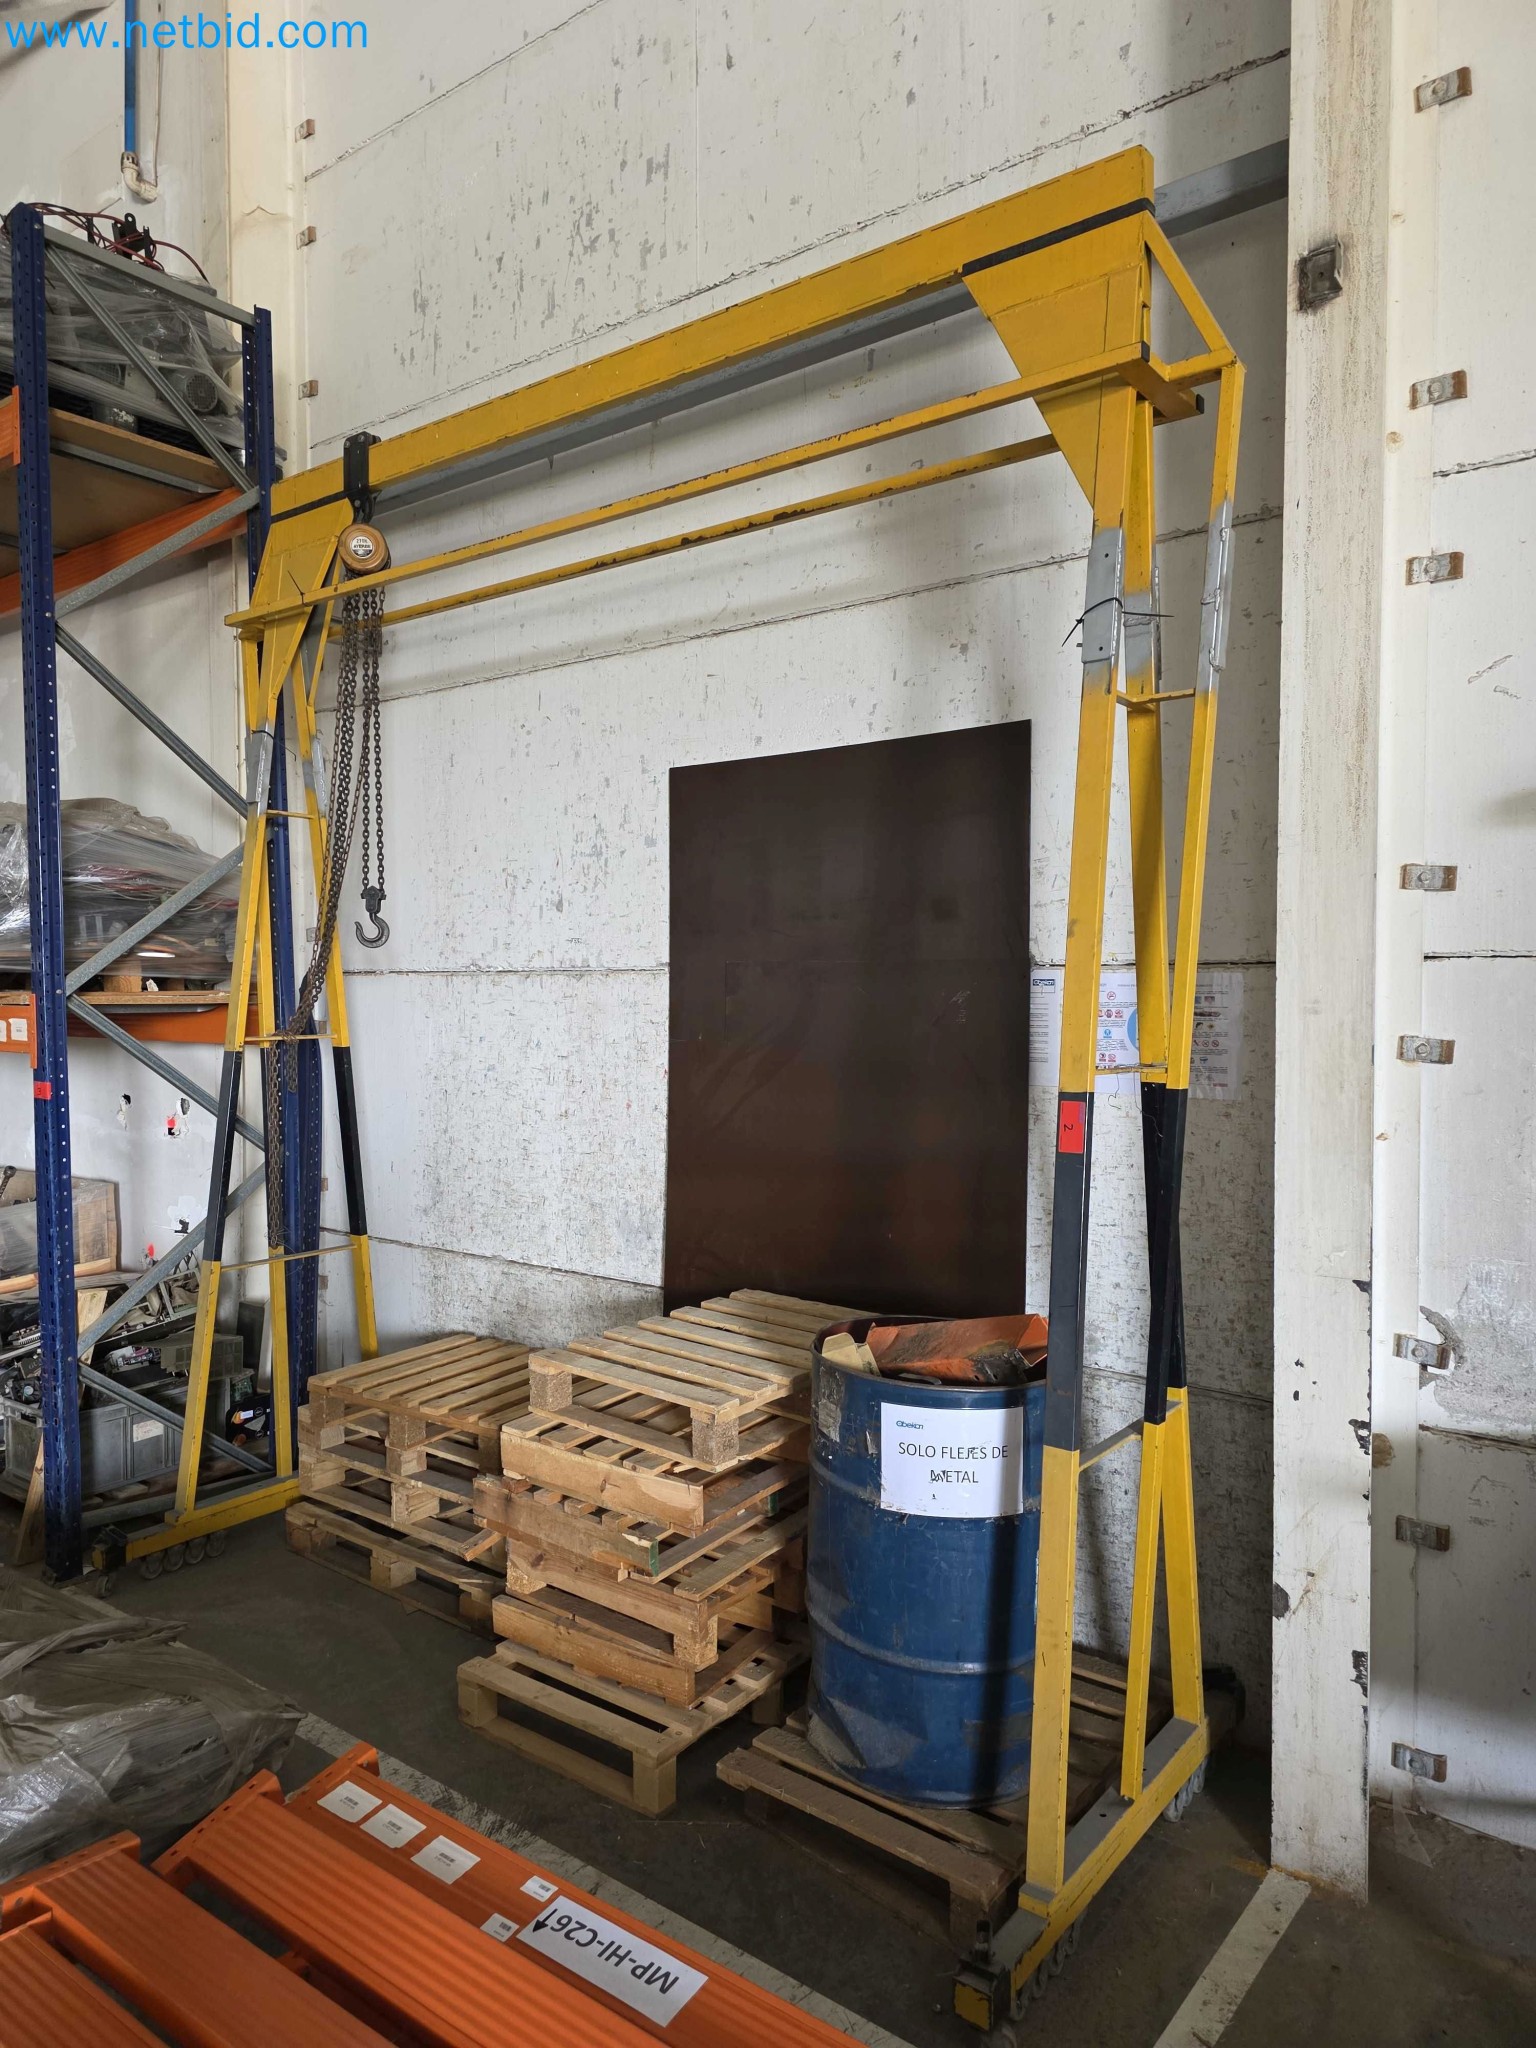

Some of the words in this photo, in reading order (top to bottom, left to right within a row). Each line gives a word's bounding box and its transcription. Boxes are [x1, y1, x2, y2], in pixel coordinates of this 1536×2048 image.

[1063, 1123, 1074, 1132] 2
[898, 1442, 936, 1458] SOLO
[941, 1446, 987, 1460] FLEJES
[992, 1445, 1009, 1458] DE
[549, 1913, 680, 1995] MP-HI-C26
